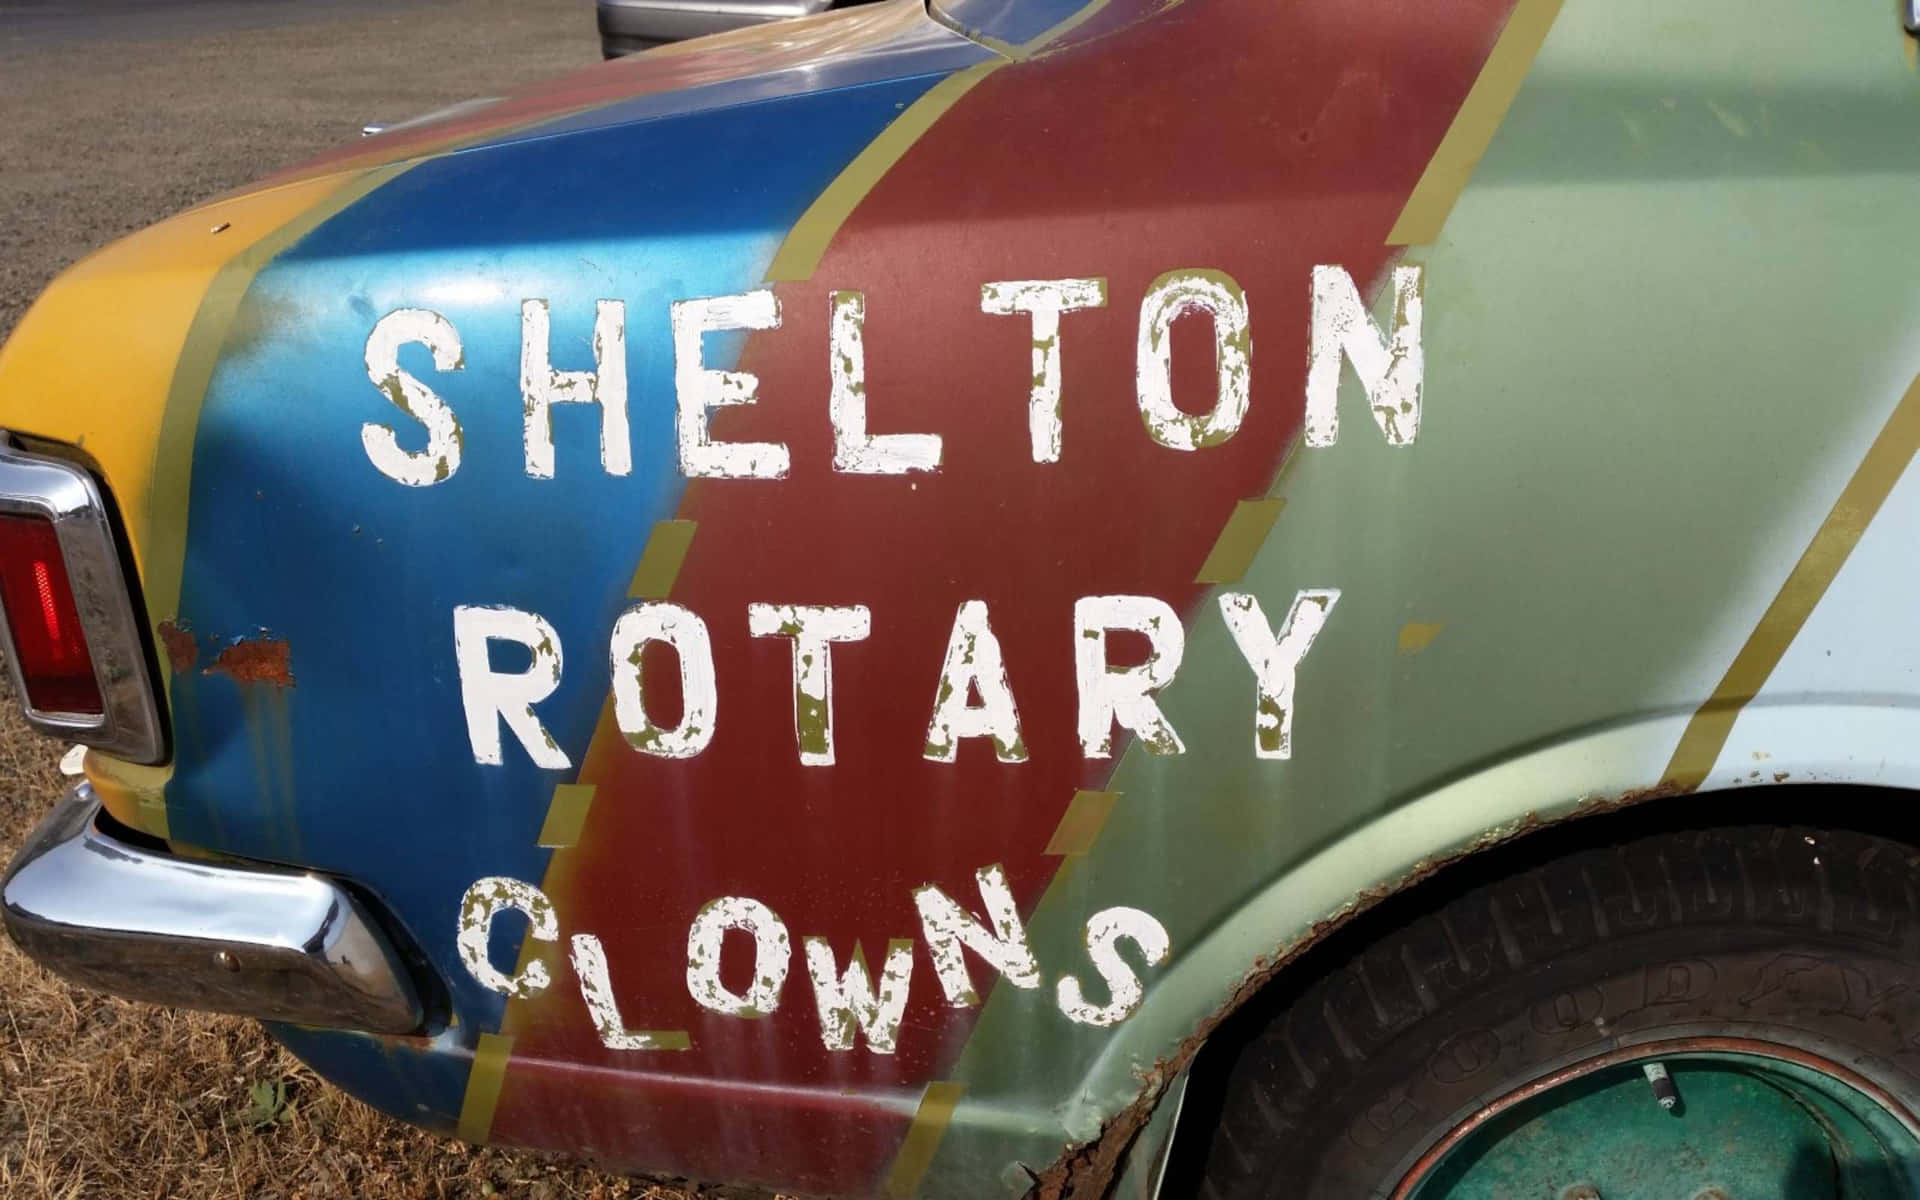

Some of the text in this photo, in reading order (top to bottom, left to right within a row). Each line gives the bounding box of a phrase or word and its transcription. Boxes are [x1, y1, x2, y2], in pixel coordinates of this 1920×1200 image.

[361, 262, 1425, 487] SHELTON
[453, 588, 1342, 770] ROTARY
[457, 862, 1171, 1054] CLOWNS
